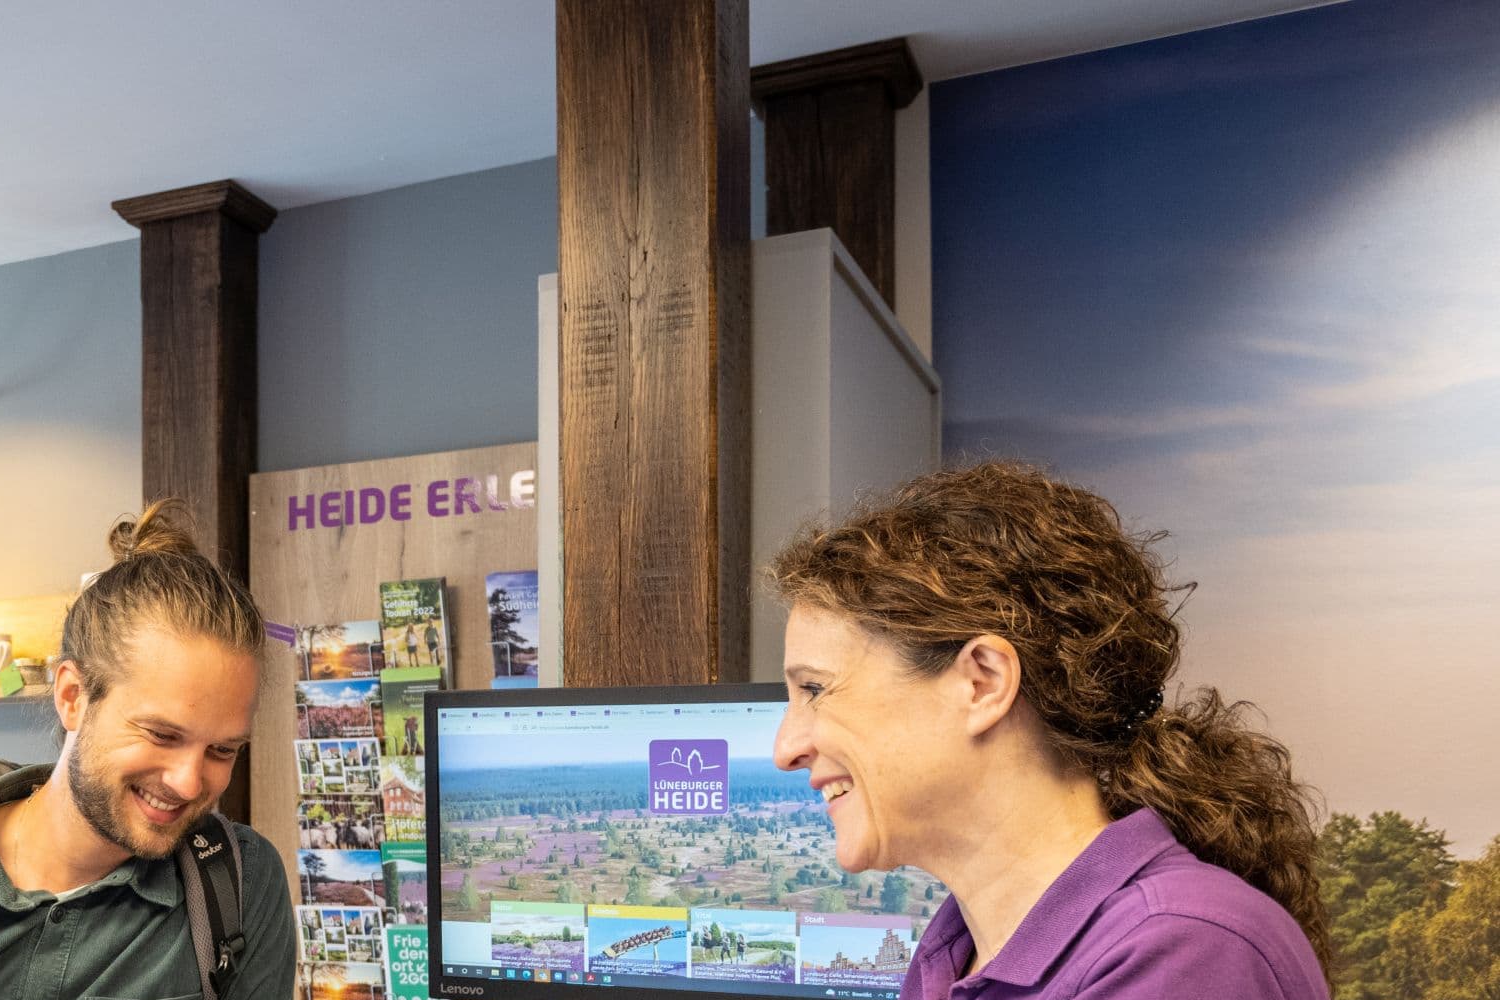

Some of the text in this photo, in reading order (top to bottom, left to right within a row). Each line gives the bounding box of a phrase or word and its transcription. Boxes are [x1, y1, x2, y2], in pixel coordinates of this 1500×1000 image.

[288, 470, 534, 531] HEIDE ERLE
[413, 606, 435, 616] 2022
[653, 779, 724, 790] LÜNEBURGER
[654, 791, 724, 810] HEIDE
[198, 842, 223, 859] deuter
[804, 915, 825, 924] Stadt
[394, 934, 421, 947] Frie
[399, 947, 428, 960] den
[392, 960, 414, 972] ort
[440, 983, 484, 995] Lenovo
